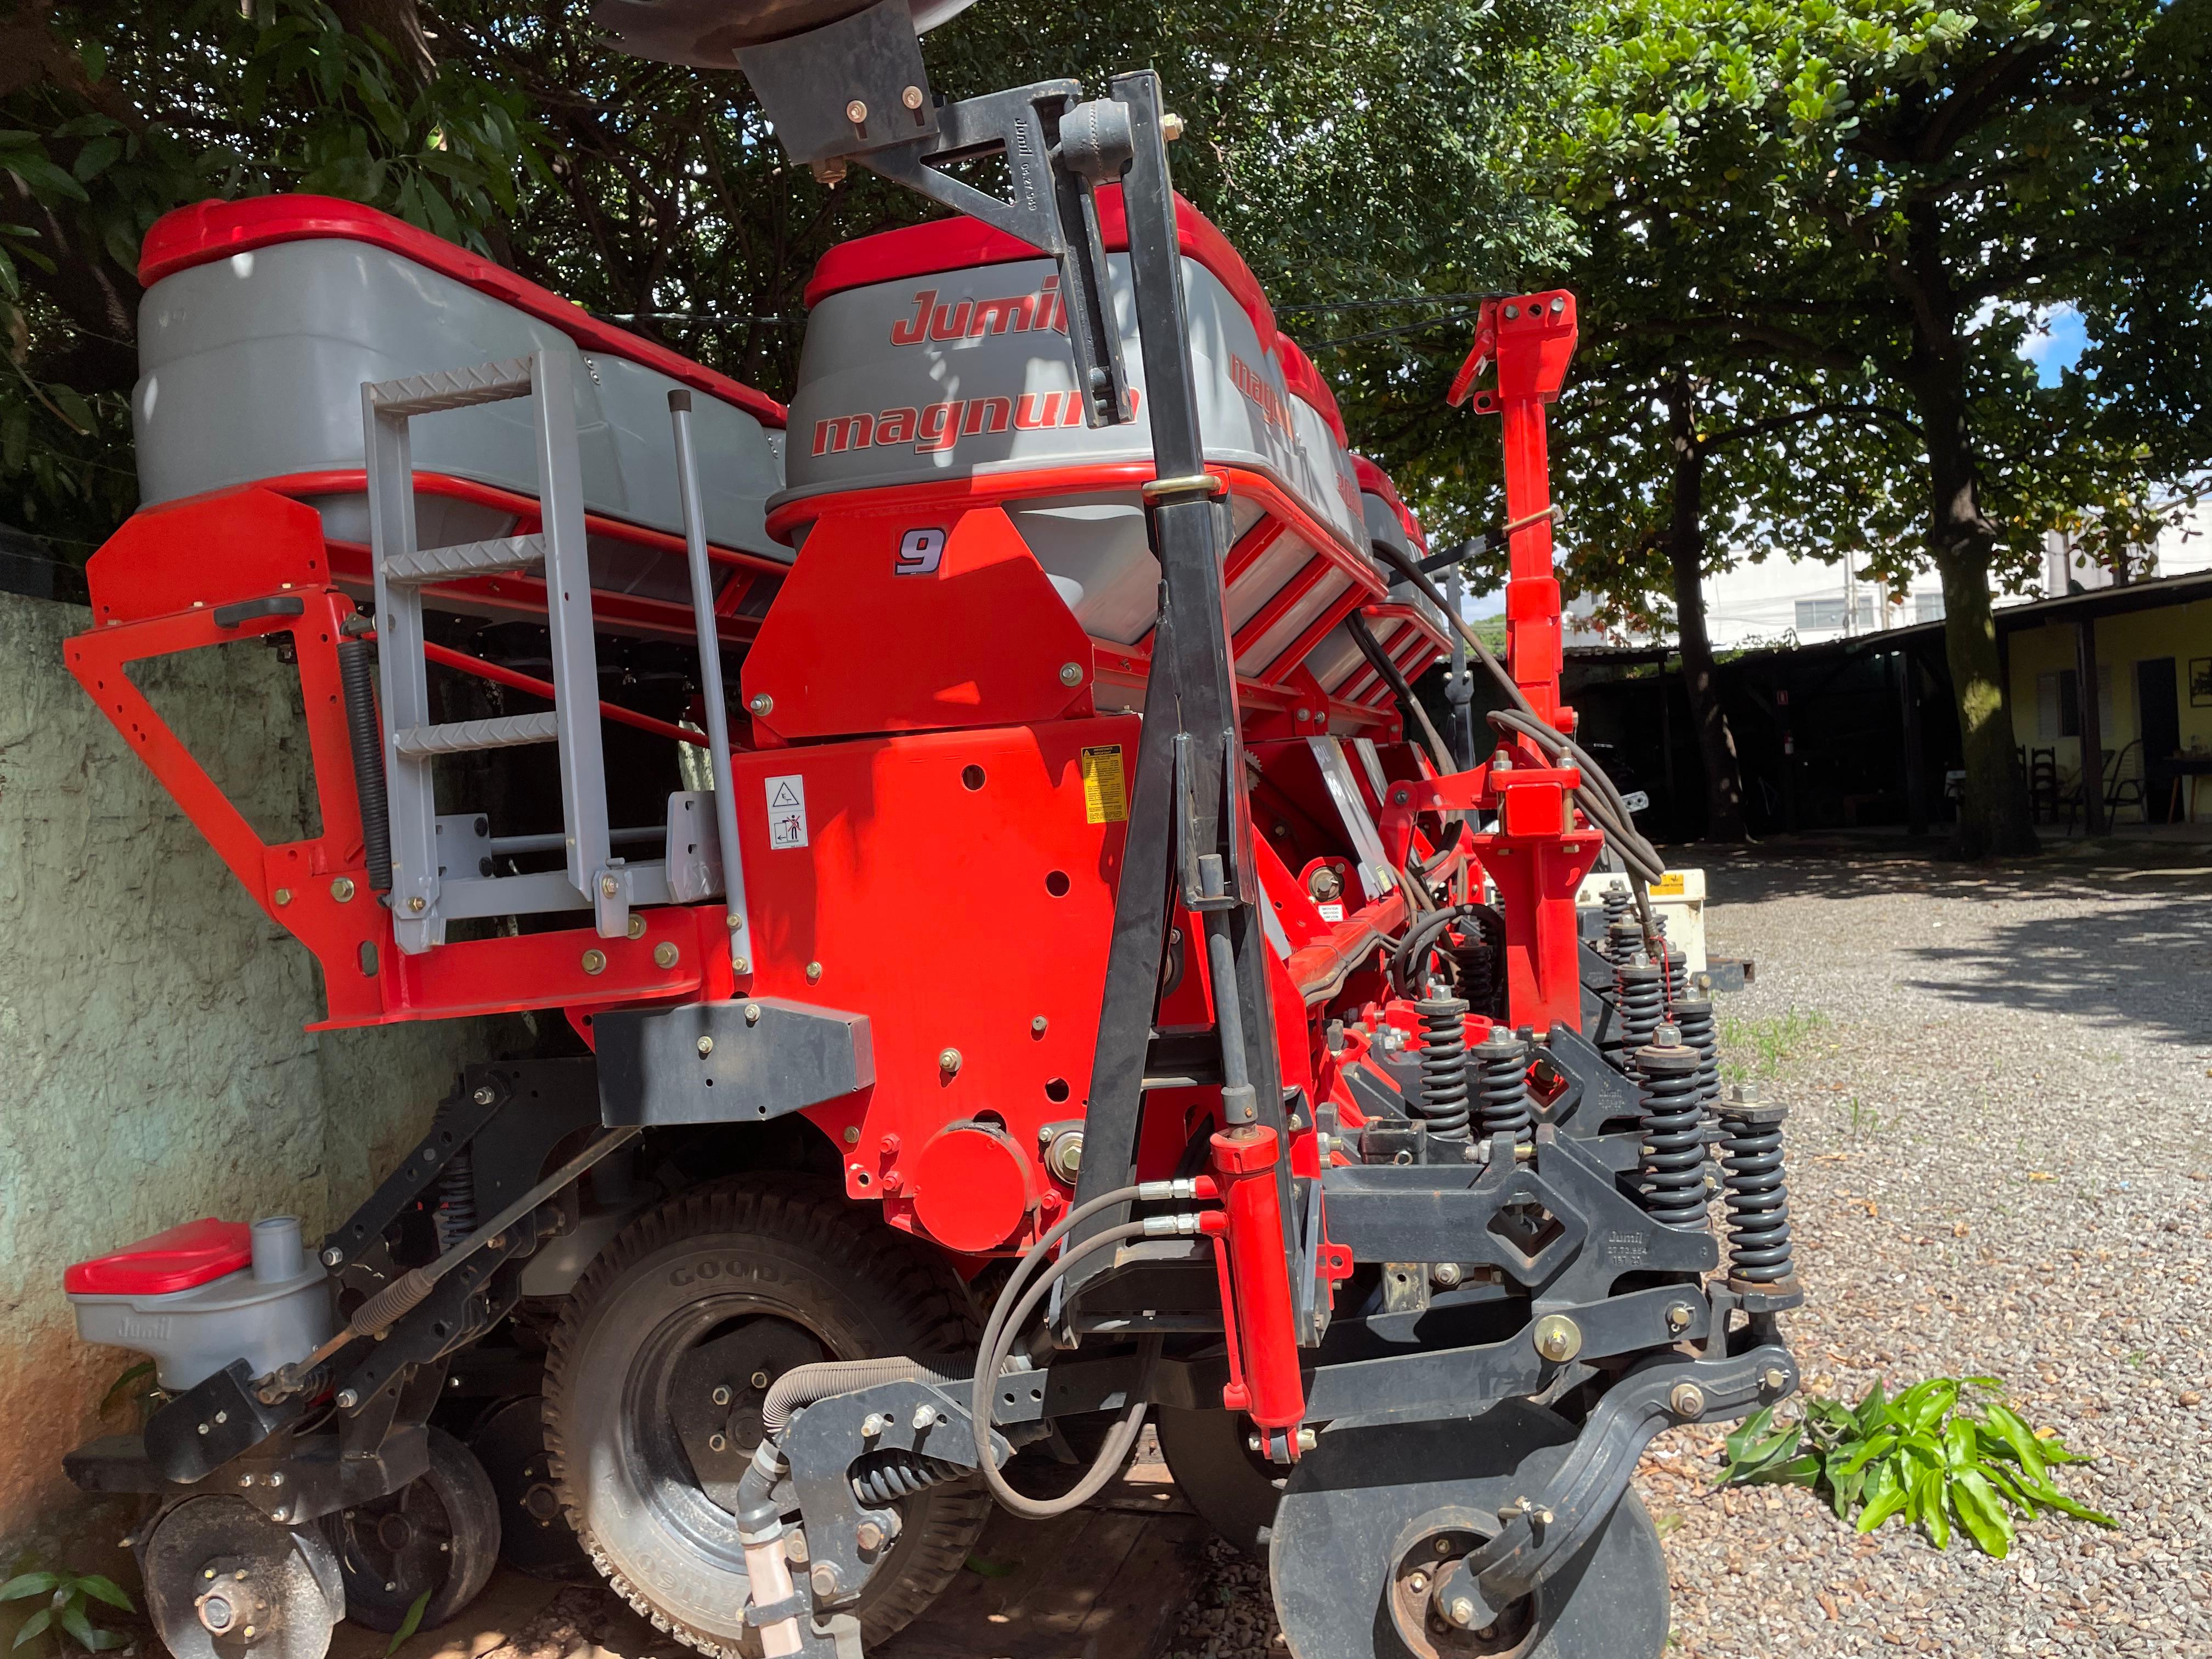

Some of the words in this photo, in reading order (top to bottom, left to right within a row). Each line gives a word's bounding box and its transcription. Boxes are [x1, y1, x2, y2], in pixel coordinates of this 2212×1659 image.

[1014, 118, 1034, 156] Jumil
[895, 527, 946, 575] 9
[1608, 1231, 1644, 1244] Jumil
[117, 1316, 172, 1339] Jumil
